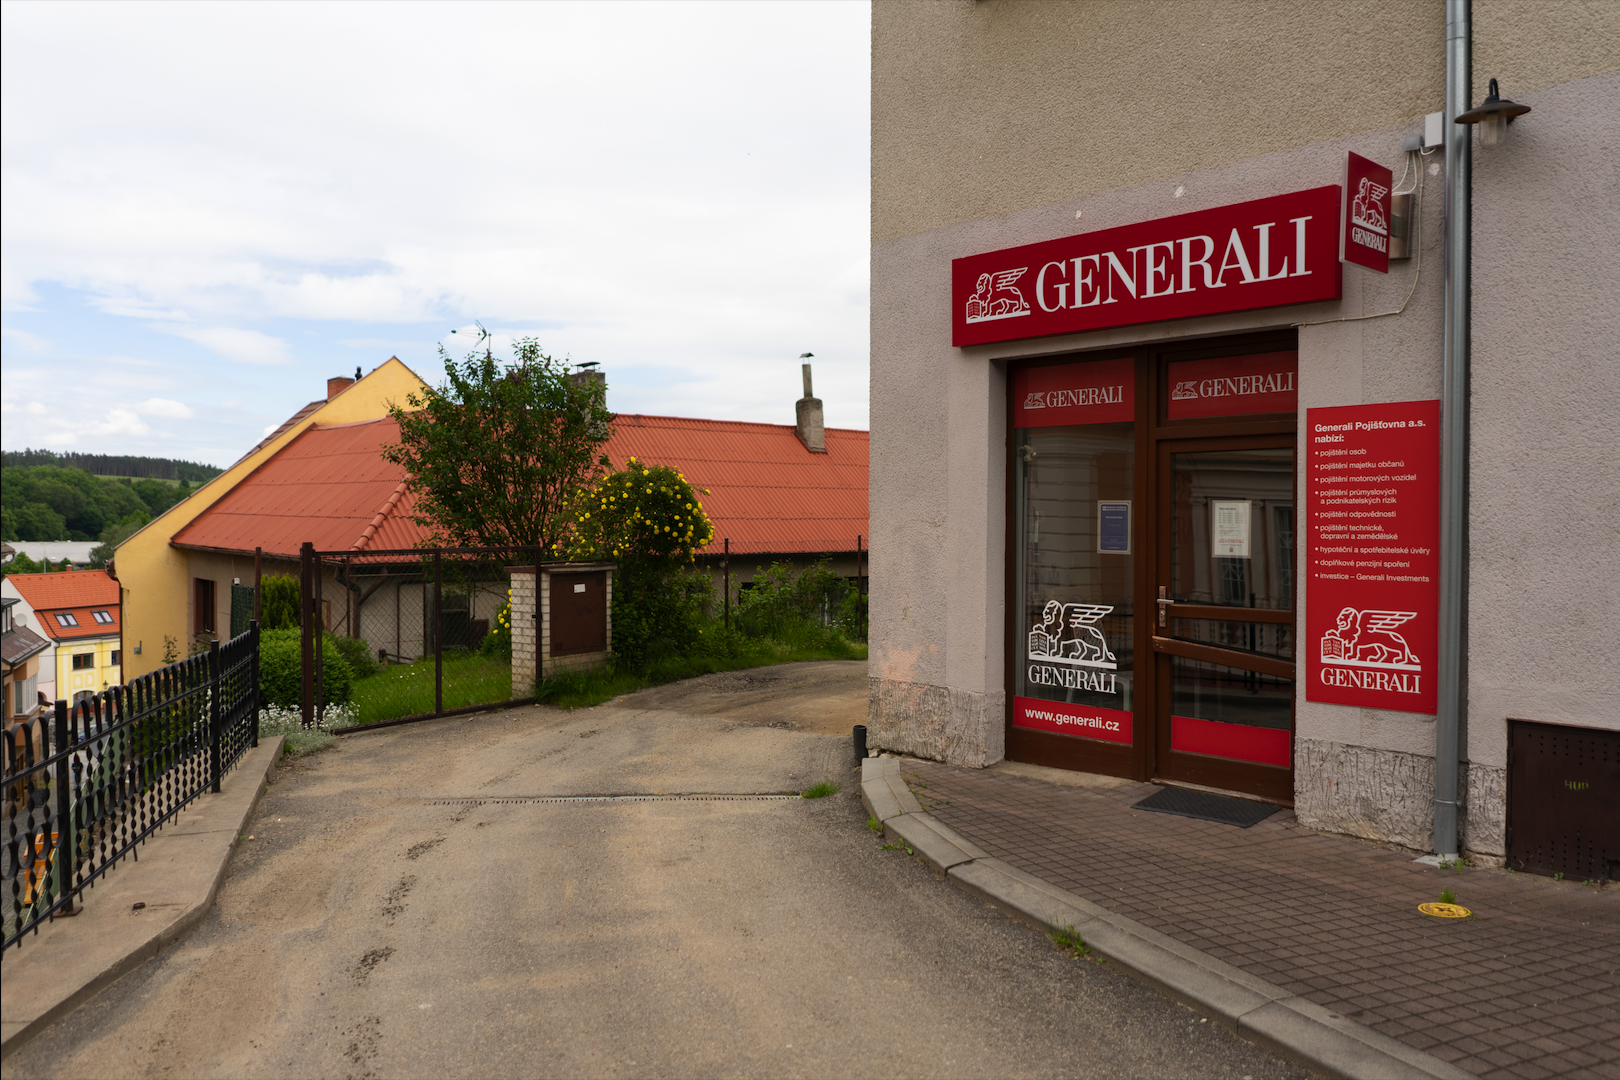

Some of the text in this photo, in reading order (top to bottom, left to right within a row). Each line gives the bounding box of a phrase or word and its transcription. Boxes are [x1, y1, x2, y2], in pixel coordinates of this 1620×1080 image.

[1351, 227, 1387, 253] GENERALI
[1035, 215, 1313, 313] GENERALI
[1200, 372, 1294, 398] GENERALI
[1046, 386, 1123, 408] GENERALI
[1315, 422, 1353, 432] Generali
[1356, 420, 1406, 431] Pojišťovna
[1315, 434, 1344, 443] nabízí:
[1320, 449, 1348, 457] pojištění
[1320, 460, 1404, 470] pojištění majetku občanů
[1320, 476, 1348, 484] pojištění
[1349, 475, 1390, 483] motorových
[1320, 488, 1397, 497] pojištění průmyslových
[1326, 496, 1381, 505] podnikatelských
[1320, 511, 1348, 519] pojištění
[1320, 524, 1384, 532] pojištění technické,
[1360, 546, 1409, 554] spotřebitelské
[1410, 547, 1430, 555] úvěry
[1320, 559, 1355, 567] doplňkové
[1356, 560, 1382, 568] penzijní
[1320, 572, 1349, 580] investice
[1356, 573, 1385, 581] Generali
[1386, 574, 1430, 582] Investments
[1028, 664, 1117, 694] GENERALI
[1320, 667, 1421, 694] GENERALI
[1025, 709, 1120, 731] www.generali.cz
